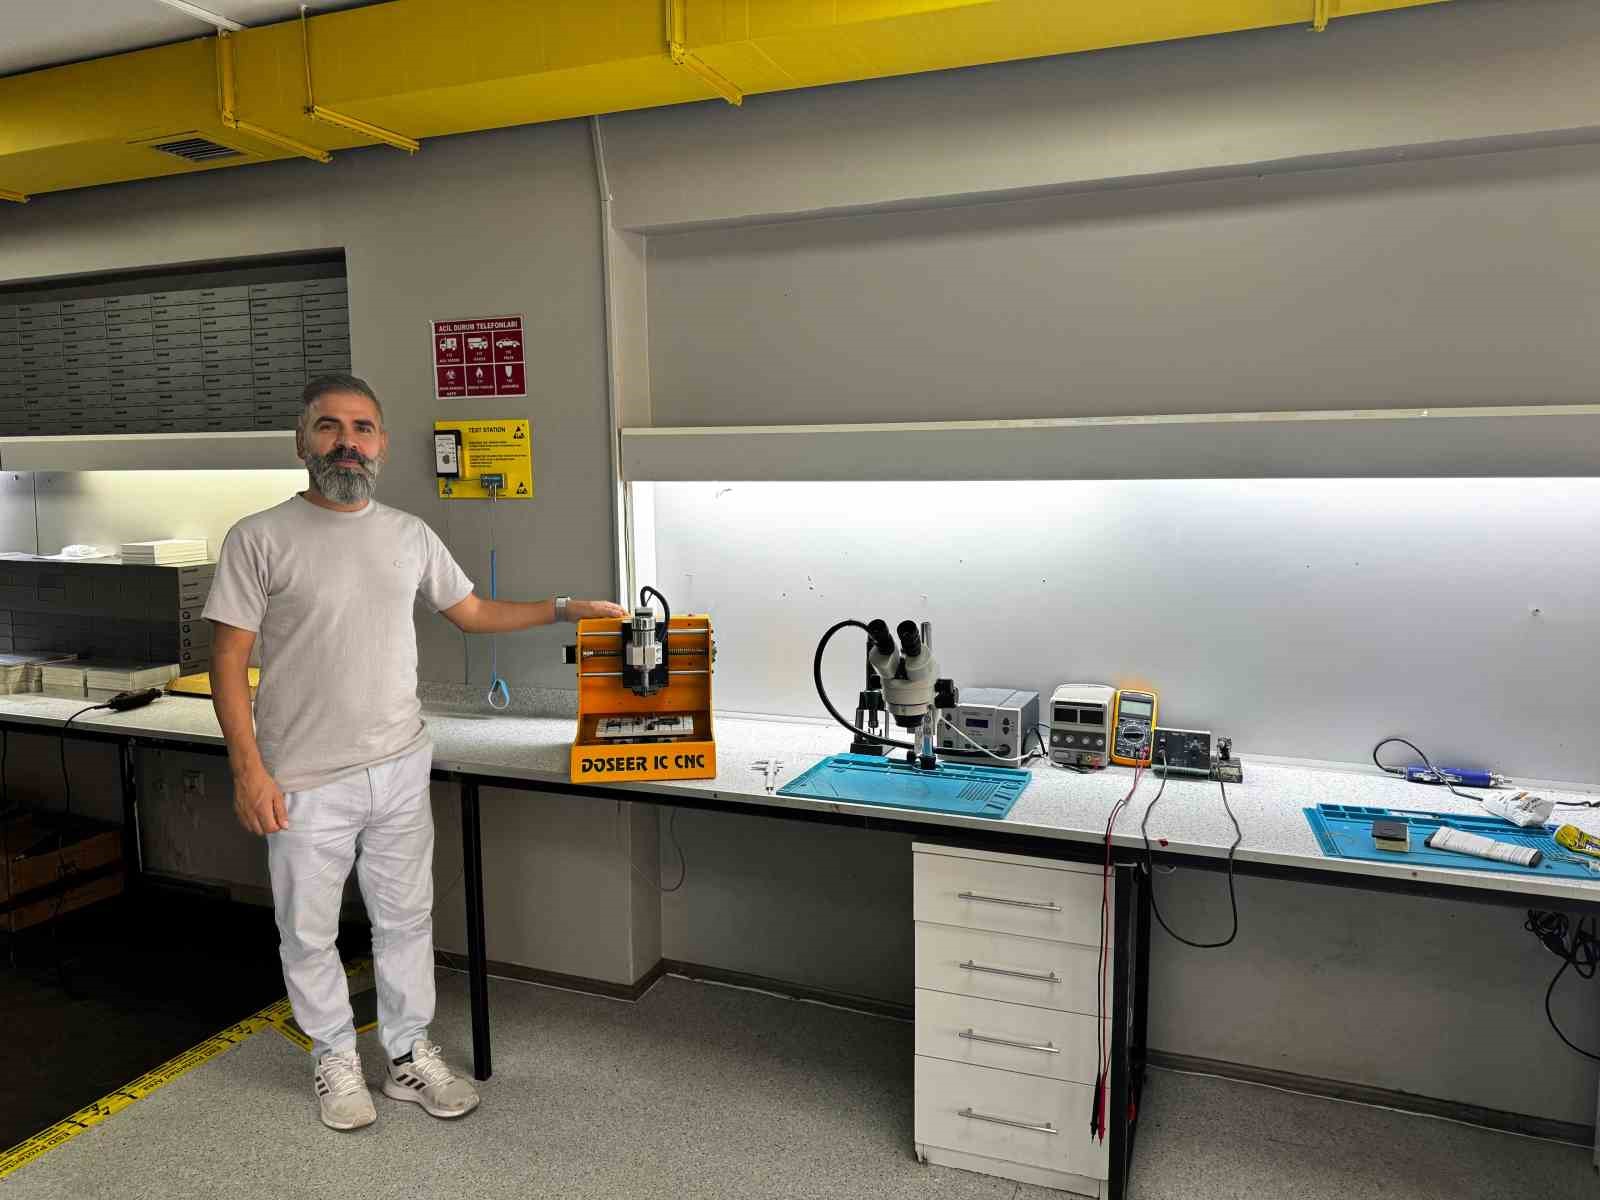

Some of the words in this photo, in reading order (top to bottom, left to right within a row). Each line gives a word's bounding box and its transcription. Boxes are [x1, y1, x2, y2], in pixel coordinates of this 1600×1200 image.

[581, 756, 648, 772] DOSEER
[654, 755, 668, 769] IC
[674, 754, 704, 769] CNC
